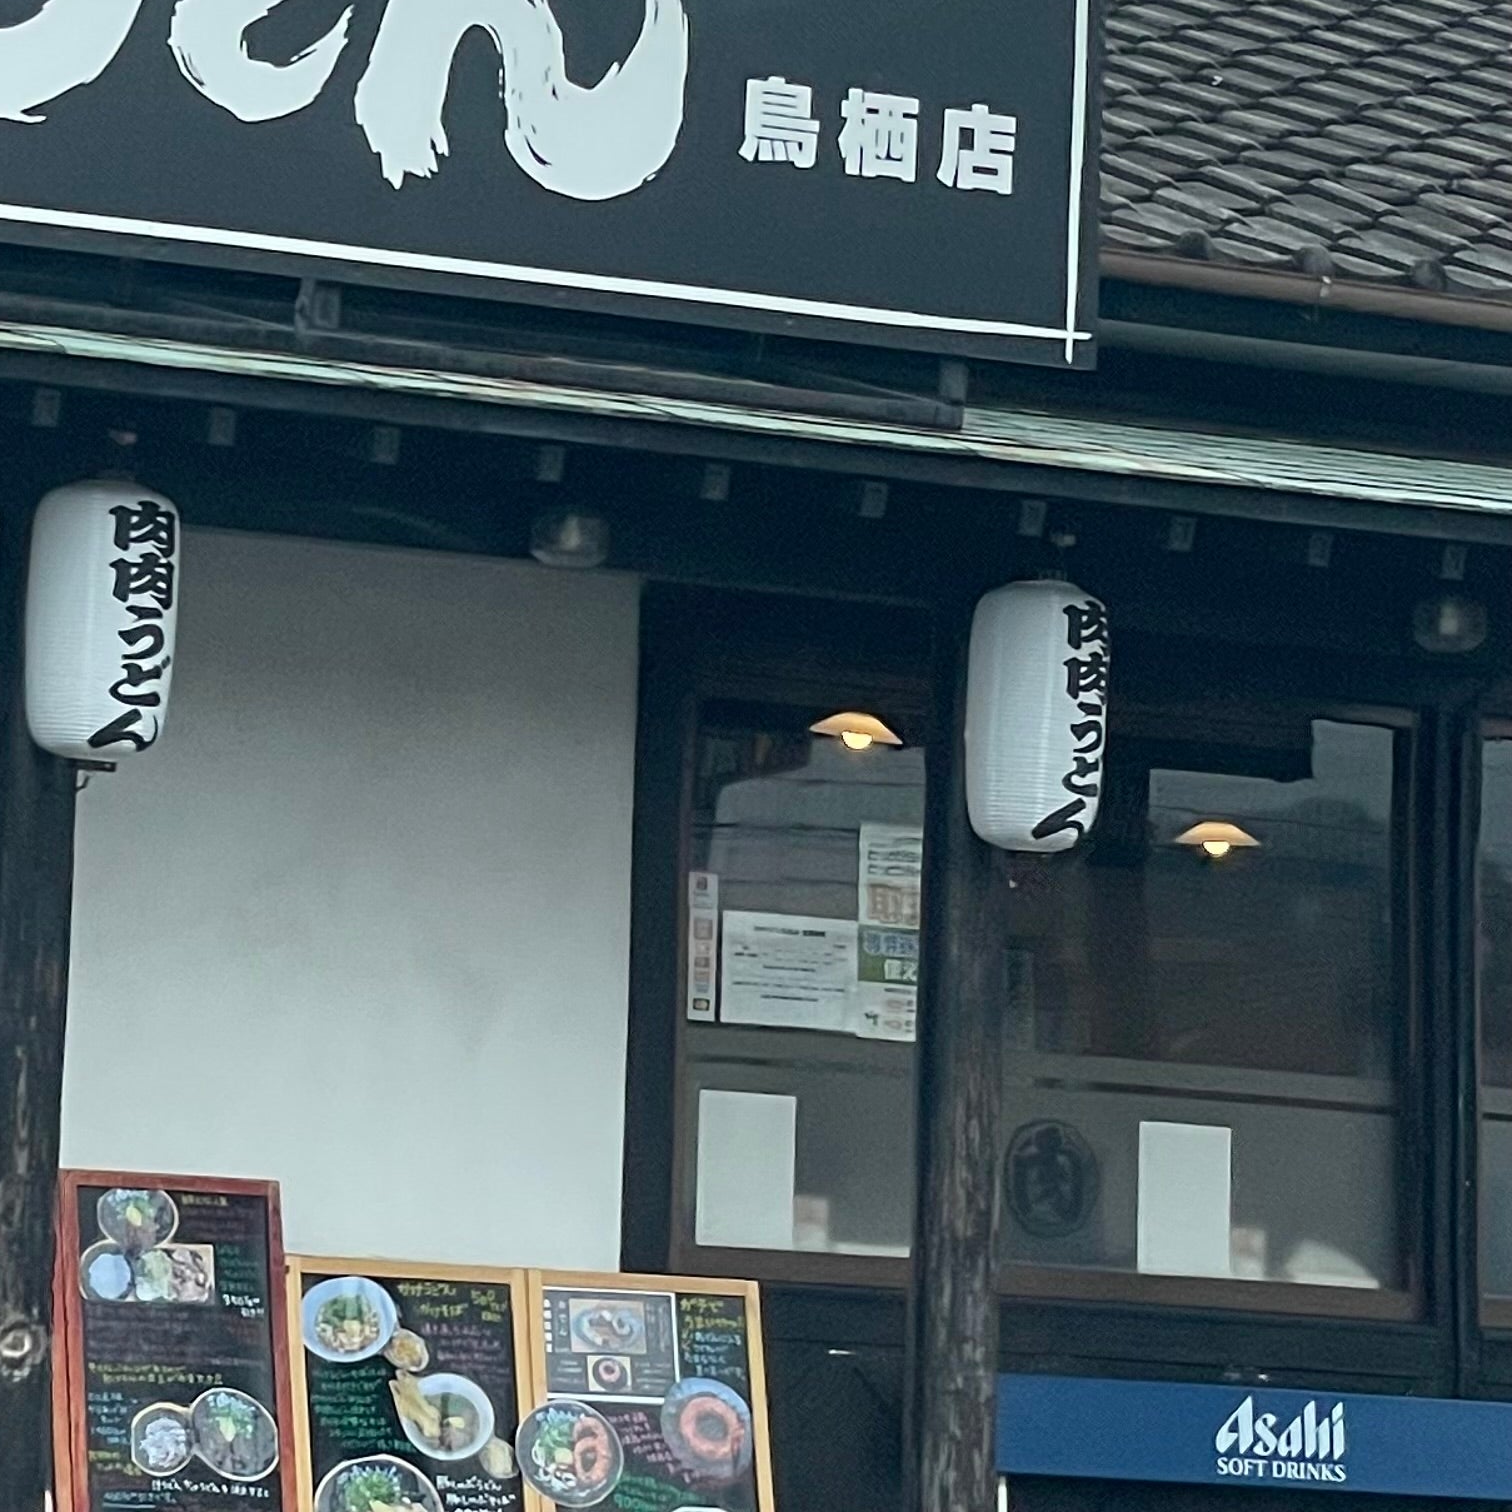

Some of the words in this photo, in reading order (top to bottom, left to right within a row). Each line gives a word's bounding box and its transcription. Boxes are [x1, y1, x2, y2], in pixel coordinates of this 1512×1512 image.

[738, 76, 1017, 195] 鳥栖店
[88, 500, 175, 752] 肉肉うどん
[1215, 1395, 1345, 1461] Asahi
[1217, 1457, 1268, 1477] SOFT
[1272, 1460, 1347, 1482] DRINKS
